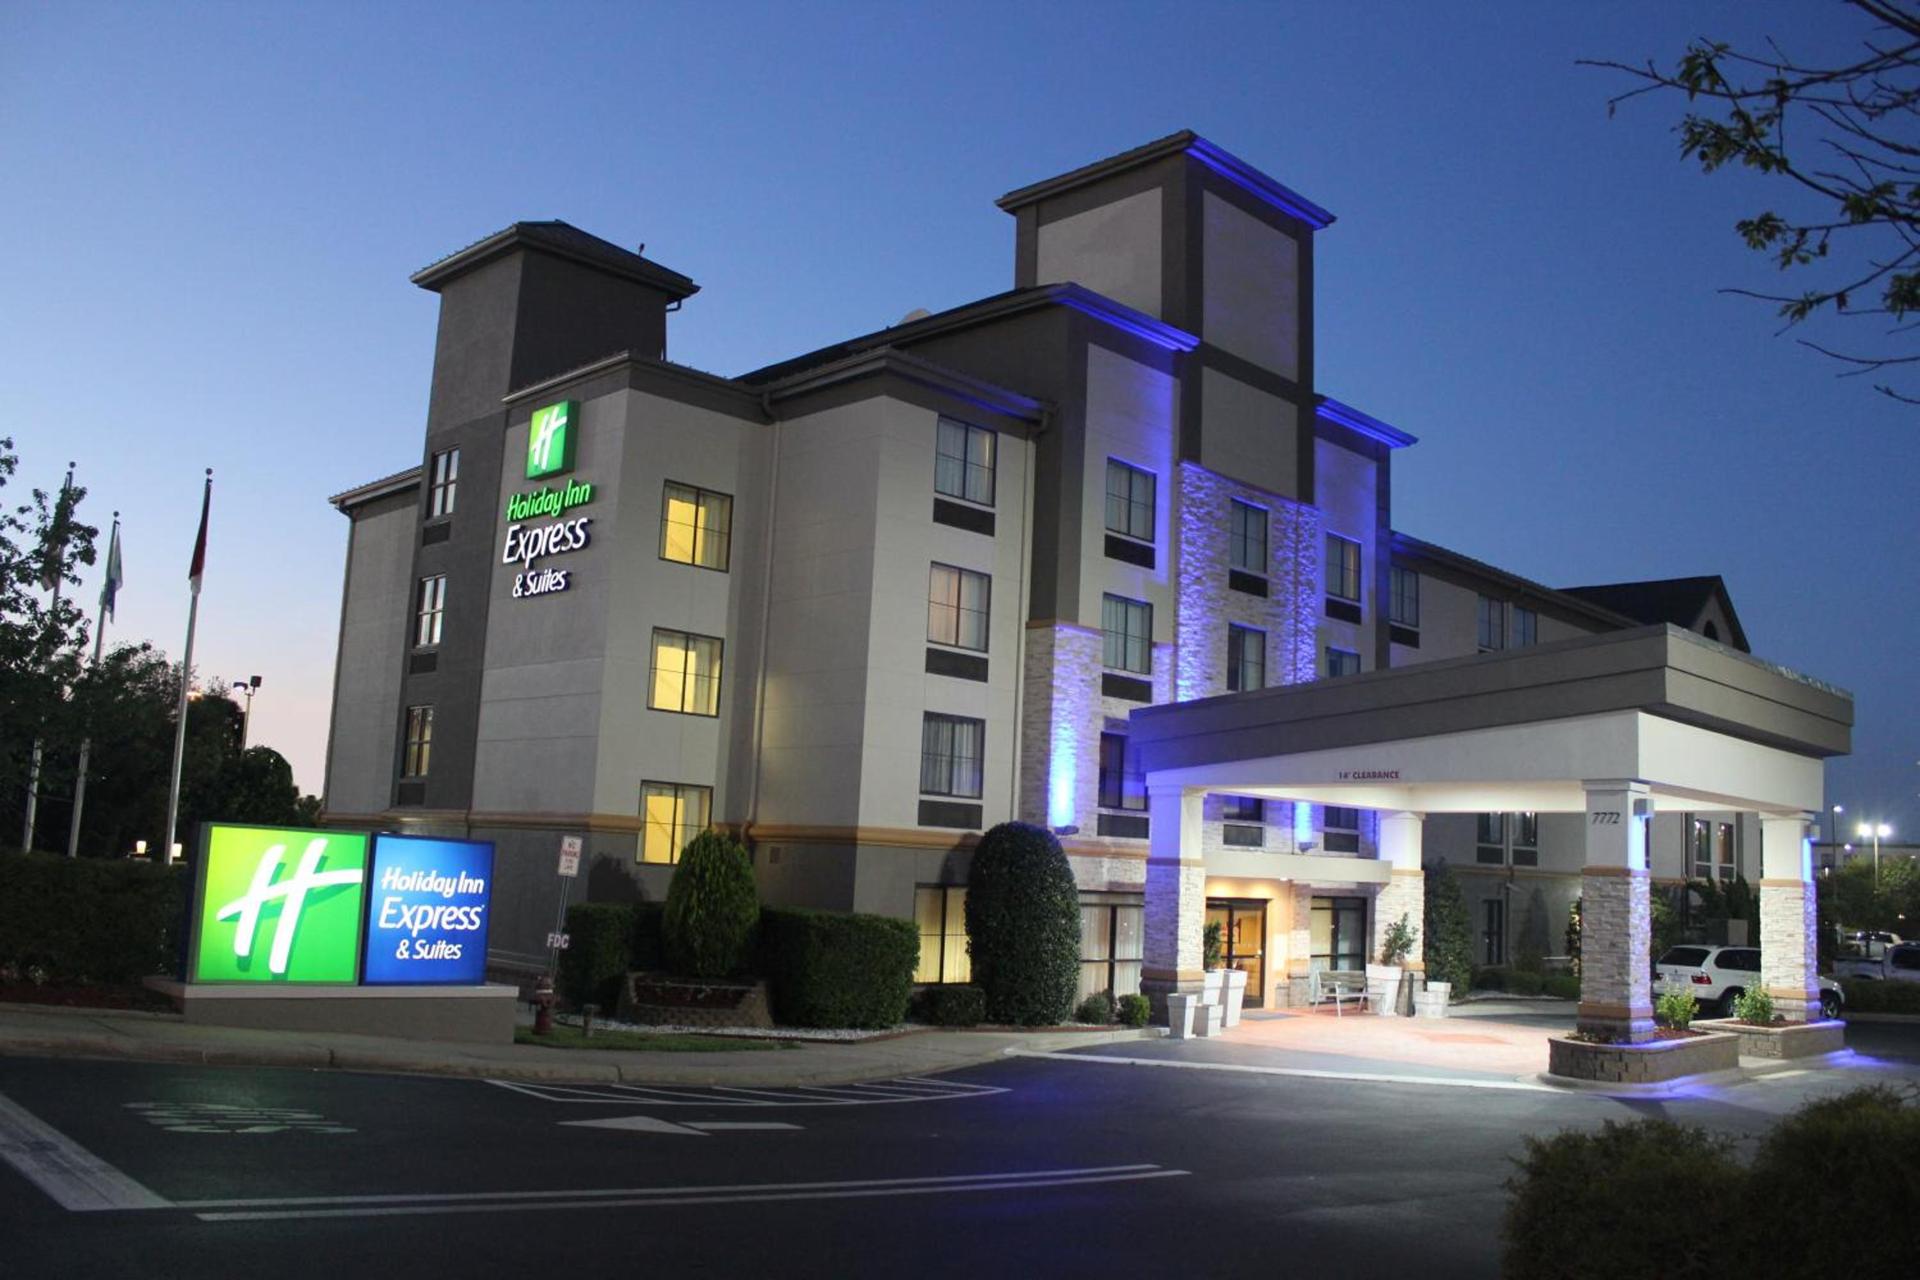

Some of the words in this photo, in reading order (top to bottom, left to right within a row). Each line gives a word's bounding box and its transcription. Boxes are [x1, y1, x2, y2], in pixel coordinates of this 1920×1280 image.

[507, 487, 564, 521] Holiday
[565, 479, 591, 507] Inn
[502, 517, 588, 569] Express
[512, 574, 523, 598] &
[525, 568, 568, 596] Suites
[1352, 770, 1400, 780] CLEARANCE
[1592, 811, 1621, 825] 7772
[381, 866, 458, 898] Holiday
[457, 870, 484, 894] Inn
[378, 896, 484, 938] Express
[395, 939, 410, 960] &
[412, 939, 462, 960] Suites
[546, 932, 570, 949] FDC
